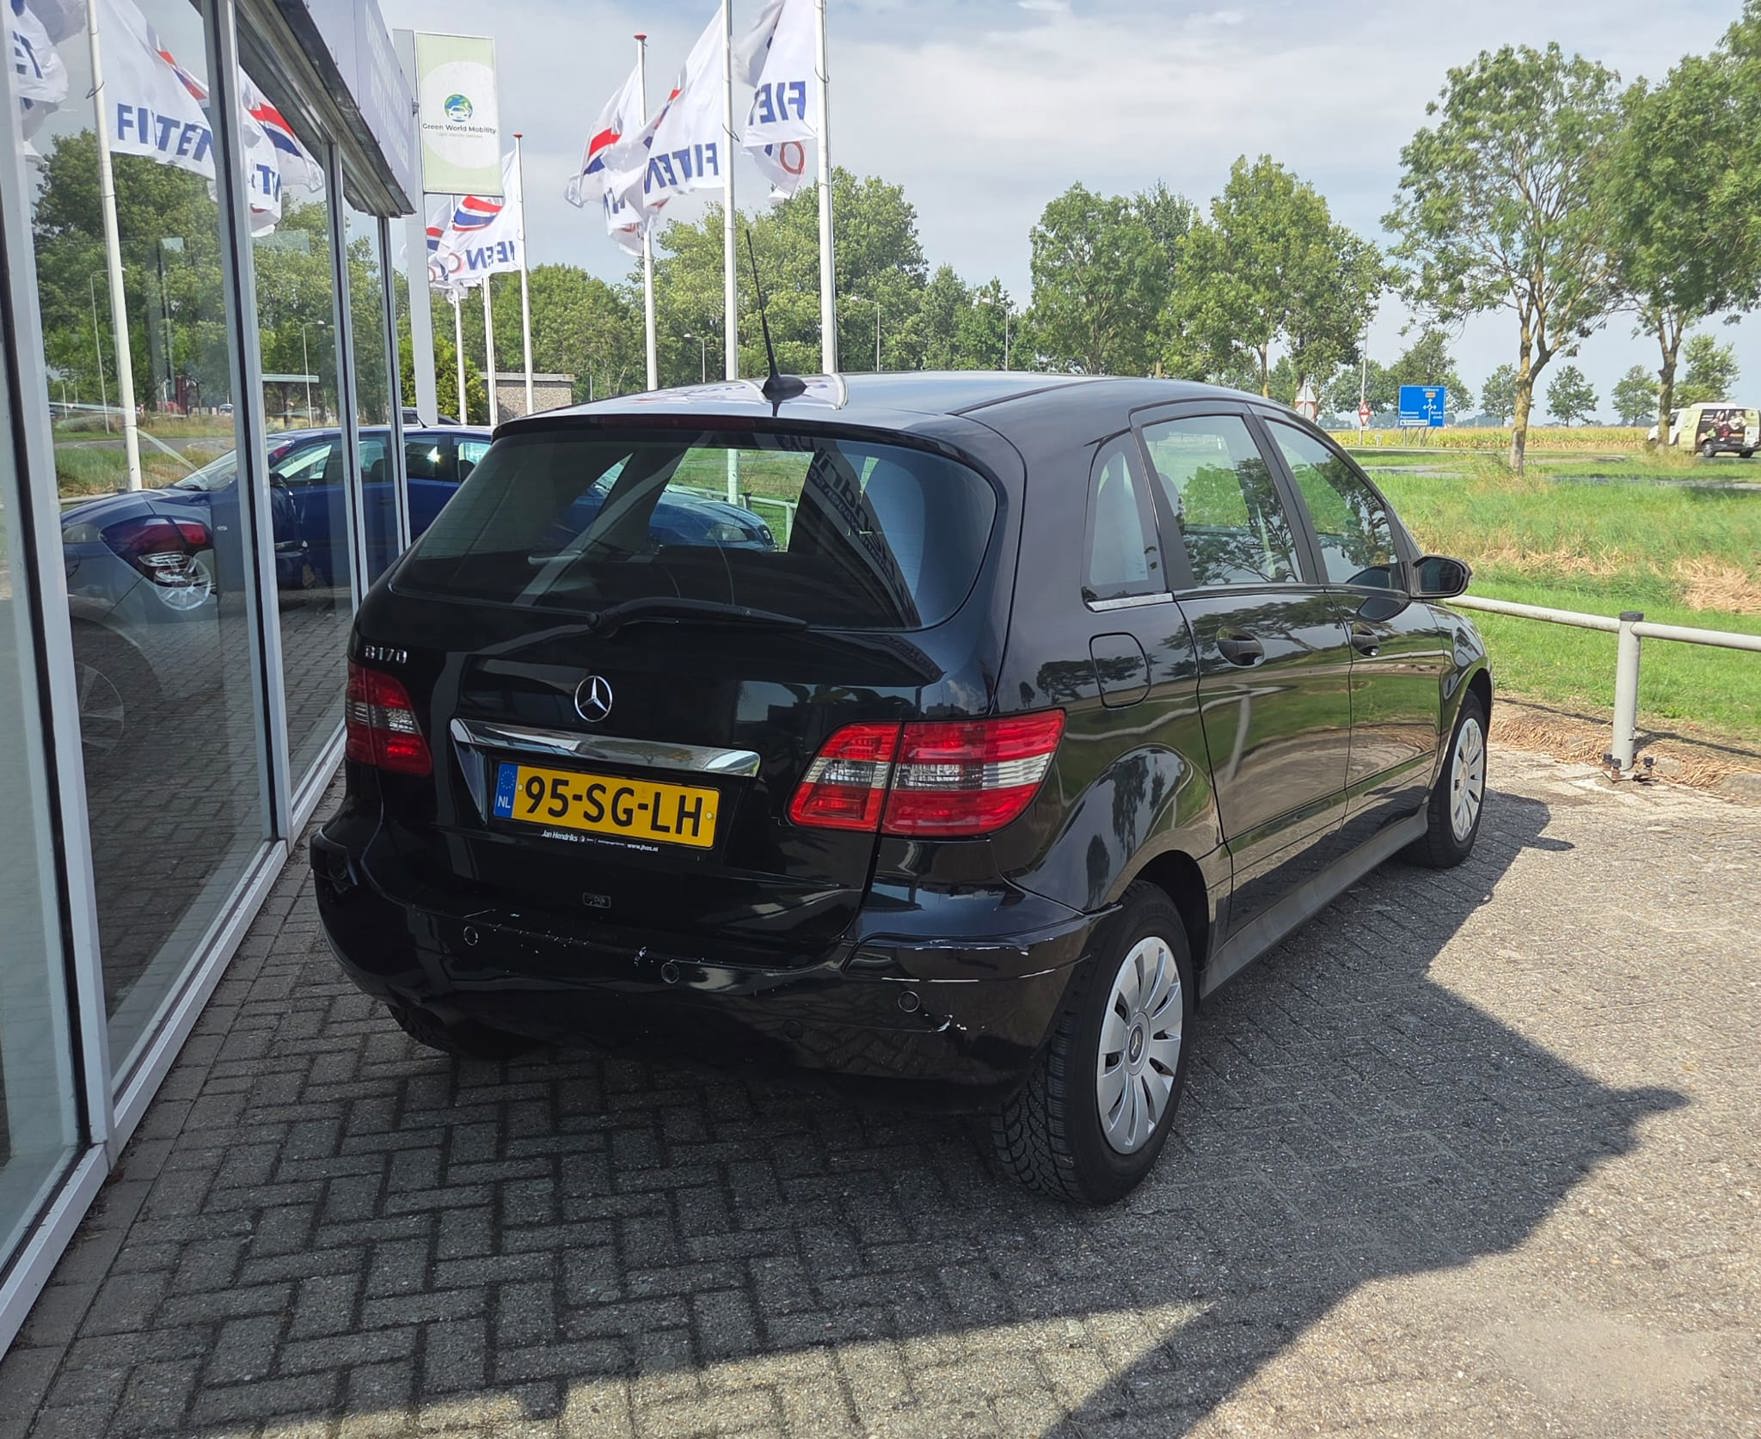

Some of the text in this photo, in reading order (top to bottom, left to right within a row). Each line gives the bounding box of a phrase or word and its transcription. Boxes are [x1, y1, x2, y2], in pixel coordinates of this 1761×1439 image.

[422, 122, 444, 131] Green
[445, 124, 467, 132] World
[468, 126, 497, 135] Mobility
[497, 774, 704, 838] NL 95-SG-LH
[541, 829, 552, 838] Jan
[552, 831, 578, 842] Hendriks
